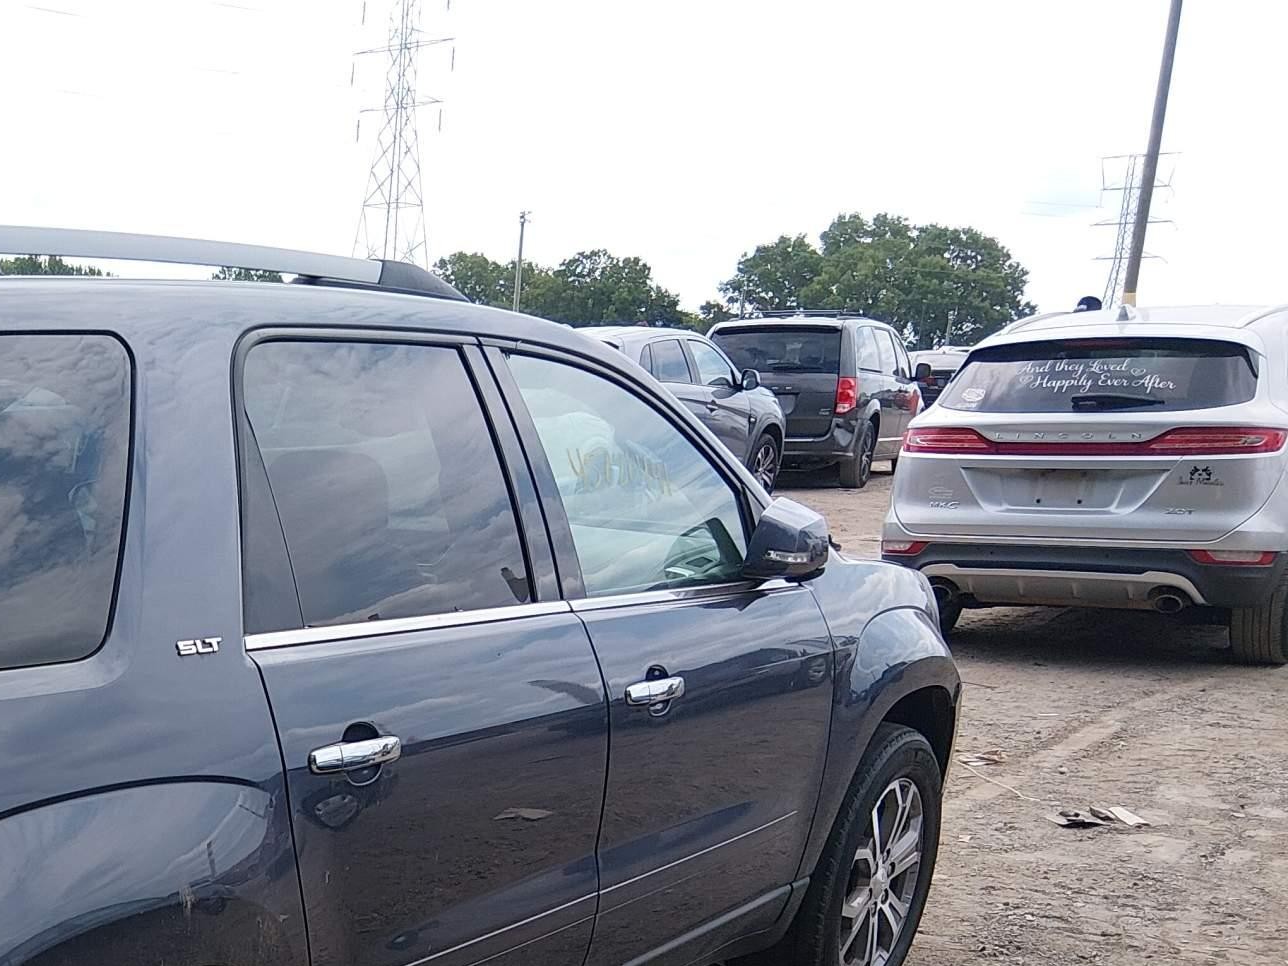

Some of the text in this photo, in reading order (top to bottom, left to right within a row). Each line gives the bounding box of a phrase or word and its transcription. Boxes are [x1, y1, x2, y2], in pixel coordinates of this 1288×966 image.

[1017, 358, 1131, 377] And they Loved
[1030, 374, 1177, 393] Happily Ever After
[995, 432, 1142, 440] LINCOLN
[176, 637, 223, 656] SLT
